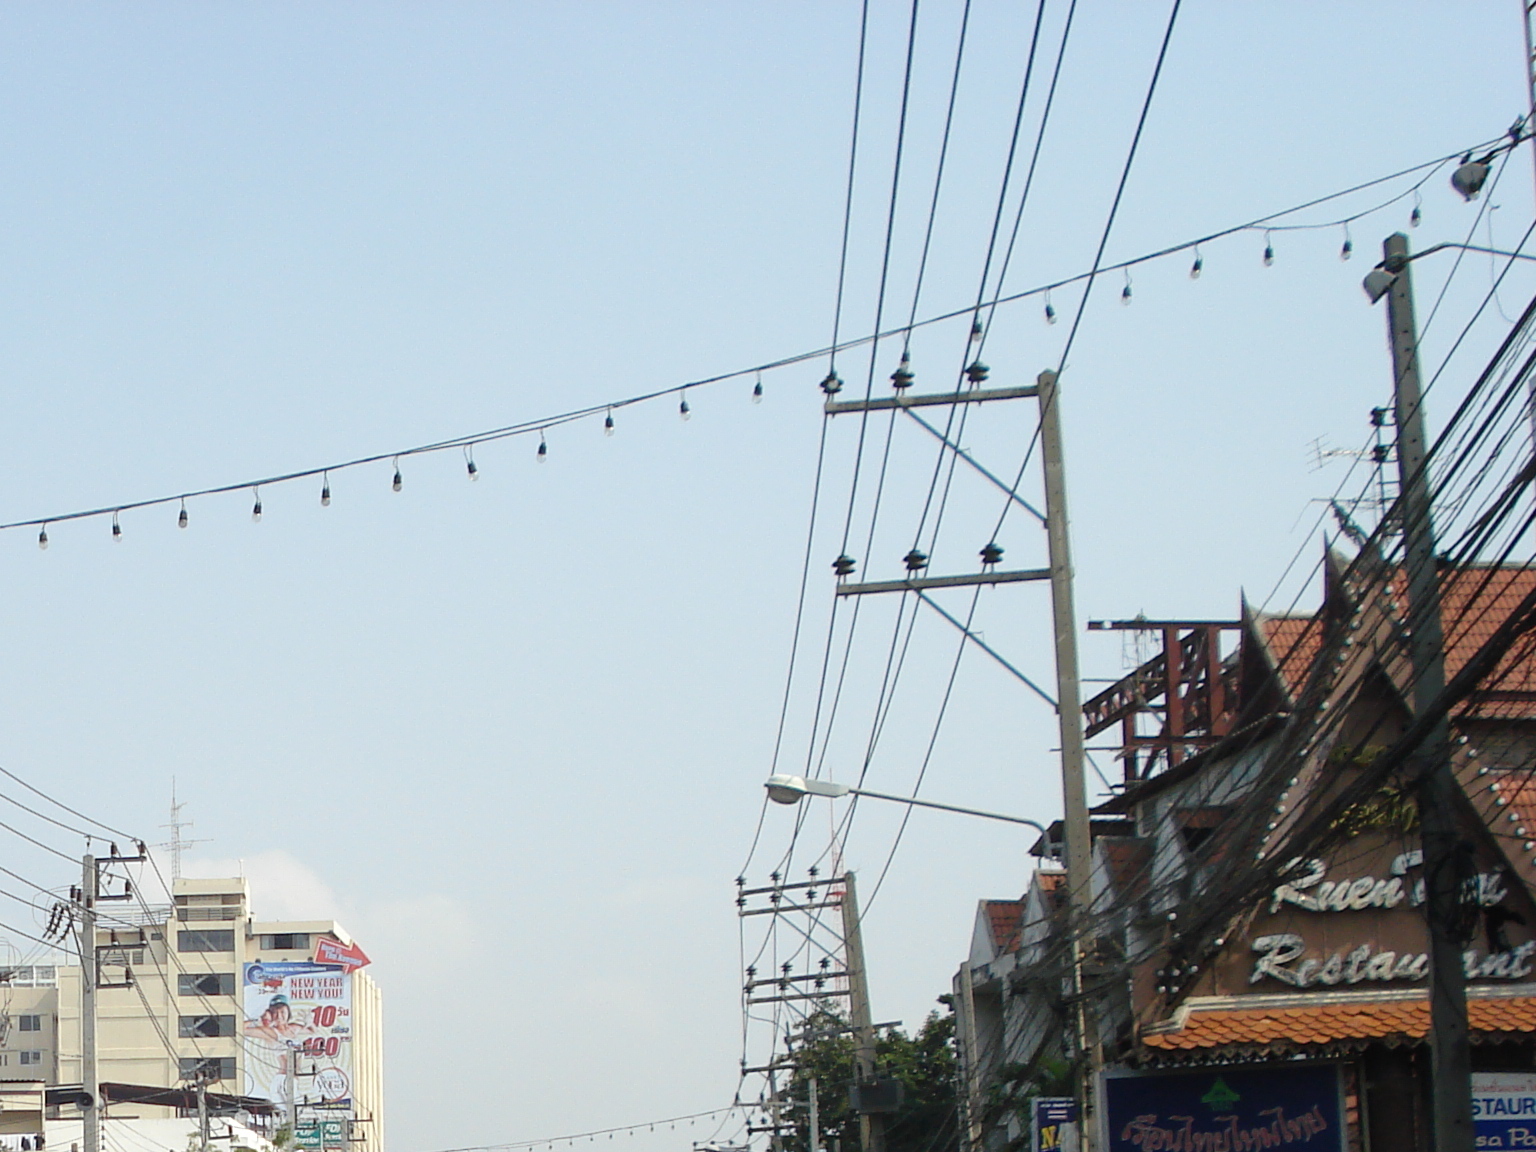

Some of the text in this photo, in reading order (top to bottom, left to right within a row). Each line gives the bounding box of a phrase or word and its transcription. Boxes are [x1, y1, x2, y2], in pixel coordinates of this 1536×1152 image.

[290, 977, 343, 988] NEW YEAR
[290, 988, 315, 999] NEW
[317, 988, 343, 999] YOU!
[311, 1005, 336, 1027] 10
